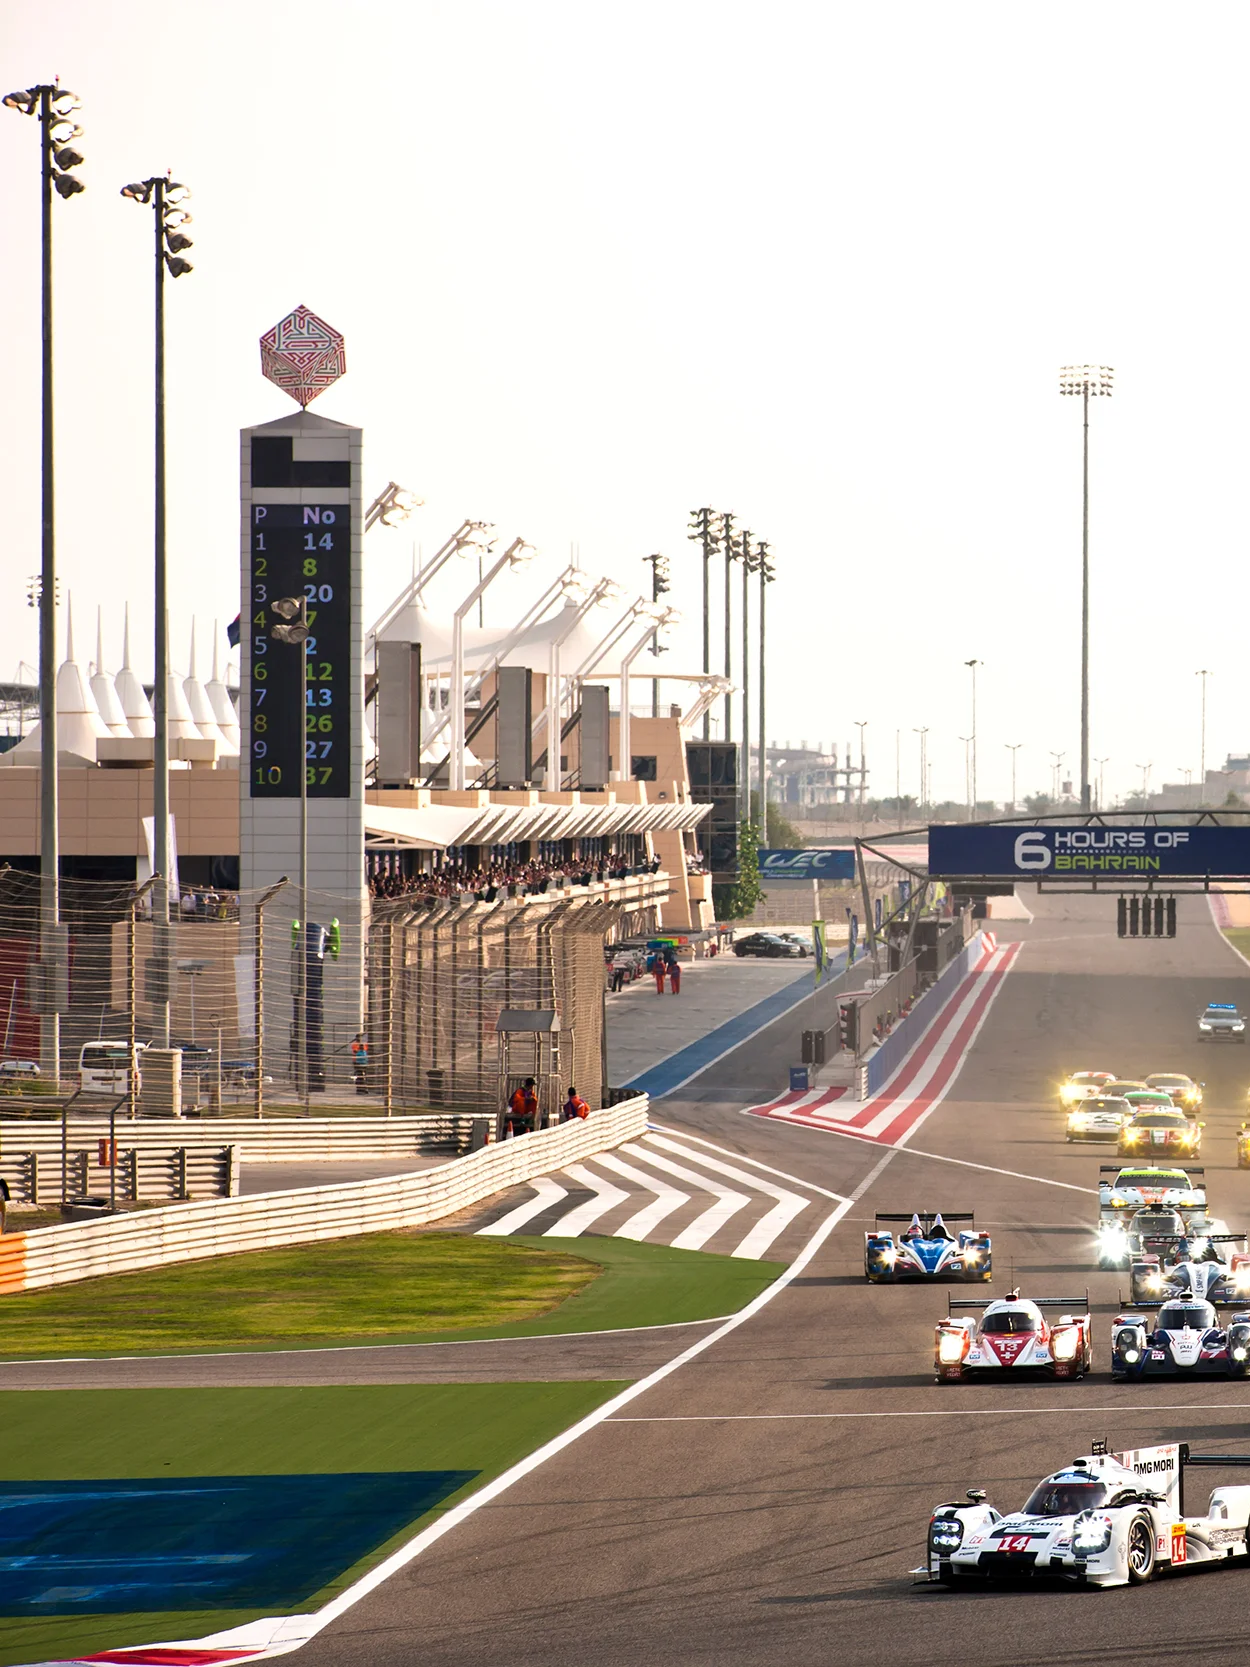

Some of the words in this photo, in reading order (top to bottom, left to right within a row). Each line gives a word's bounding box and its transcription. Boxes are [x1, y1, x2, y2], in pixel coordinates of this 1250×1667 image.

[255, 506, 267, 524] P
[303, 506, 336, 525] No
[256, 532, 267, 550] 1
[303, 532, 334, 551] 14
[254, 558, 268, 576] 2
[302, 558, 318, 577] 8
[254, 584, 267, 602] 3
[303, 584, 334, 603] 20
[253, 610, 267, 628] 4
[305, 611, 318, 628] 7
[254, 636, 268, 654] 5
[305, 636, 318, 655] 2
[254, 662, 268, 681] 6
[305, 662, 333, 681] 12
[254, 688, 267, 706] 7
[305, 688, 333, 707] 13
[254, 714, 267, 733] 8
[305, 714, 333, 733] 26
[253, 740, 267, 759] 9
[305, 740, 333, 759] 27
[255, 766, 282, 785] 10
[305, 767, 333, 785] 37
[763, 851, 832, 868] WEC
[1014, 831, 1052, 870] 6
[1054, 831, 1146, 848] HOURS
[1153, 831, 1190, 848] OF
[1054, 855, 1161, 870] BAHRAIN
[1162, 1288, 1182, 1298] 27
[999, 1343, 1018, 1352] 13
[1210, 1350, 1221, 1358] 7
[1133, 1461, 1152, 1475] DMG
[1153, 1458, 1174, 1473] MORI
[999, 1536, 1029, 1551] 14
[1172, 1536, 1185, 1561] 14
